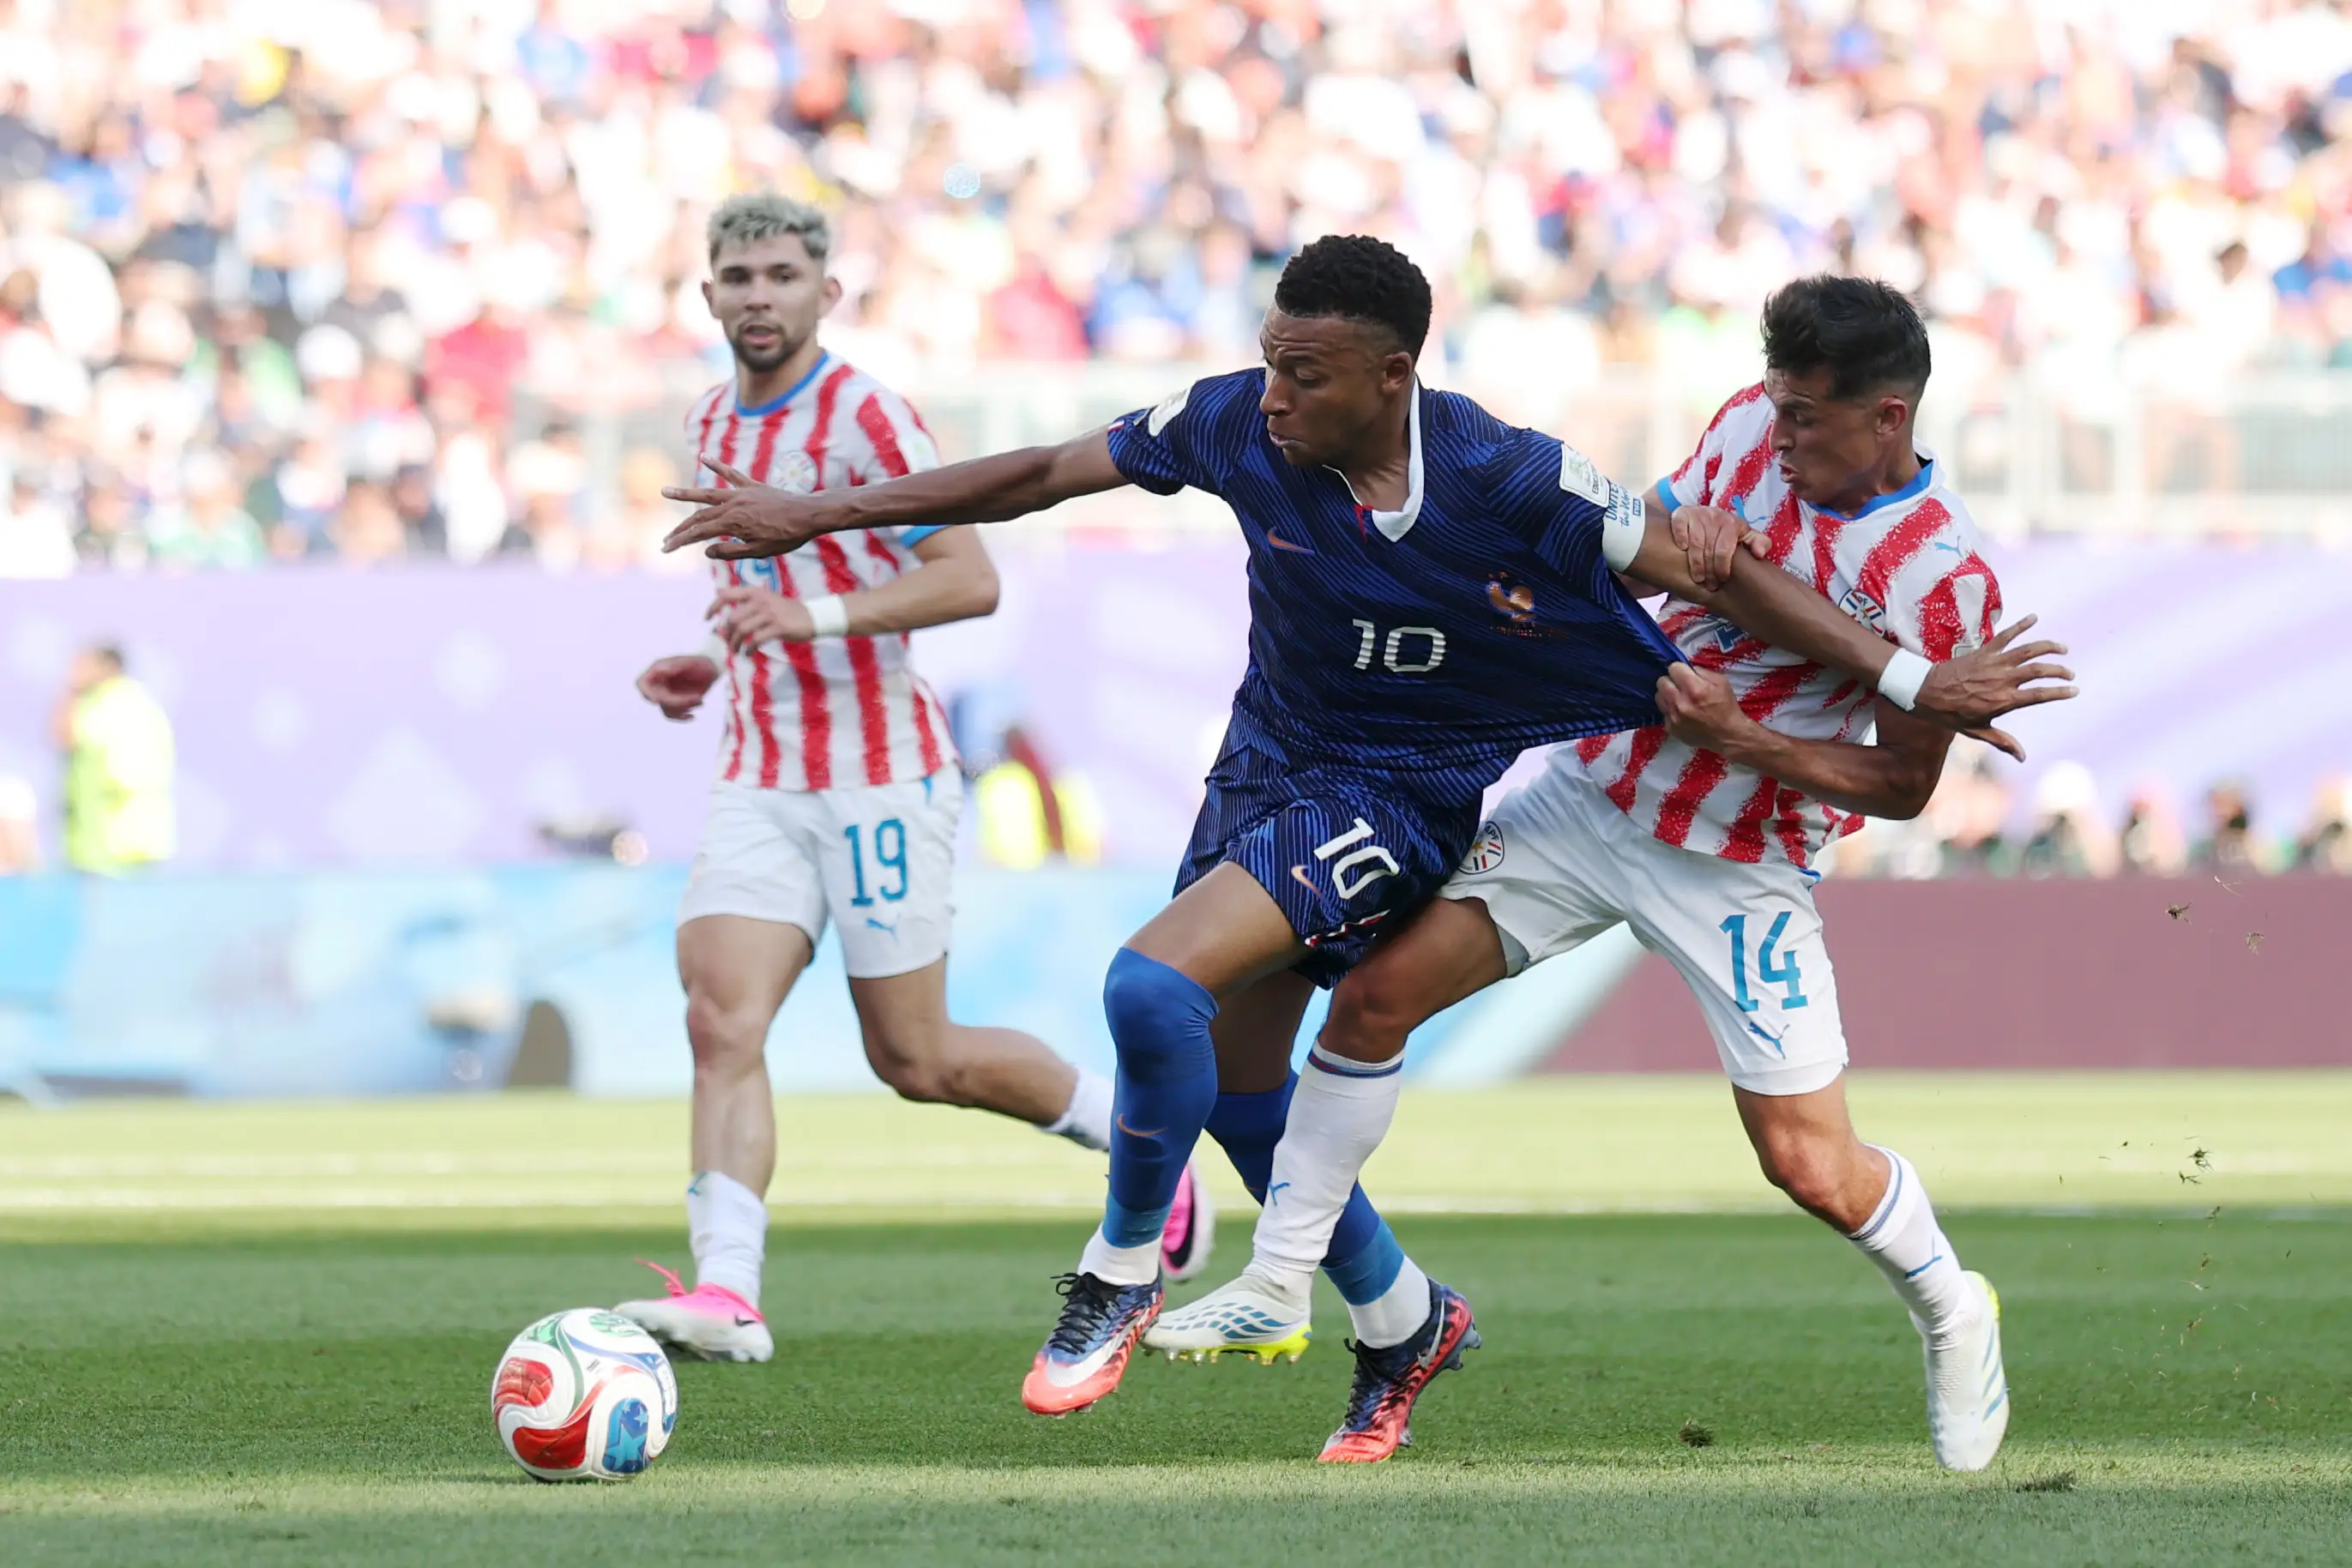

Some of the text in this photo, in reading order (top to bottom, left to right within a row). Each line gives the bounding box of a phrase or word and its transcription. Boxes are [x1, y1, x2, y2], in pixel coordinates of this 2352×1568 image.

[1353, 618, 1447, 672] 10
[844, 818, 908, 907] 19
[1313, 817, 1400, 900] 10
[1718, 911, 1808, 1012] 14
